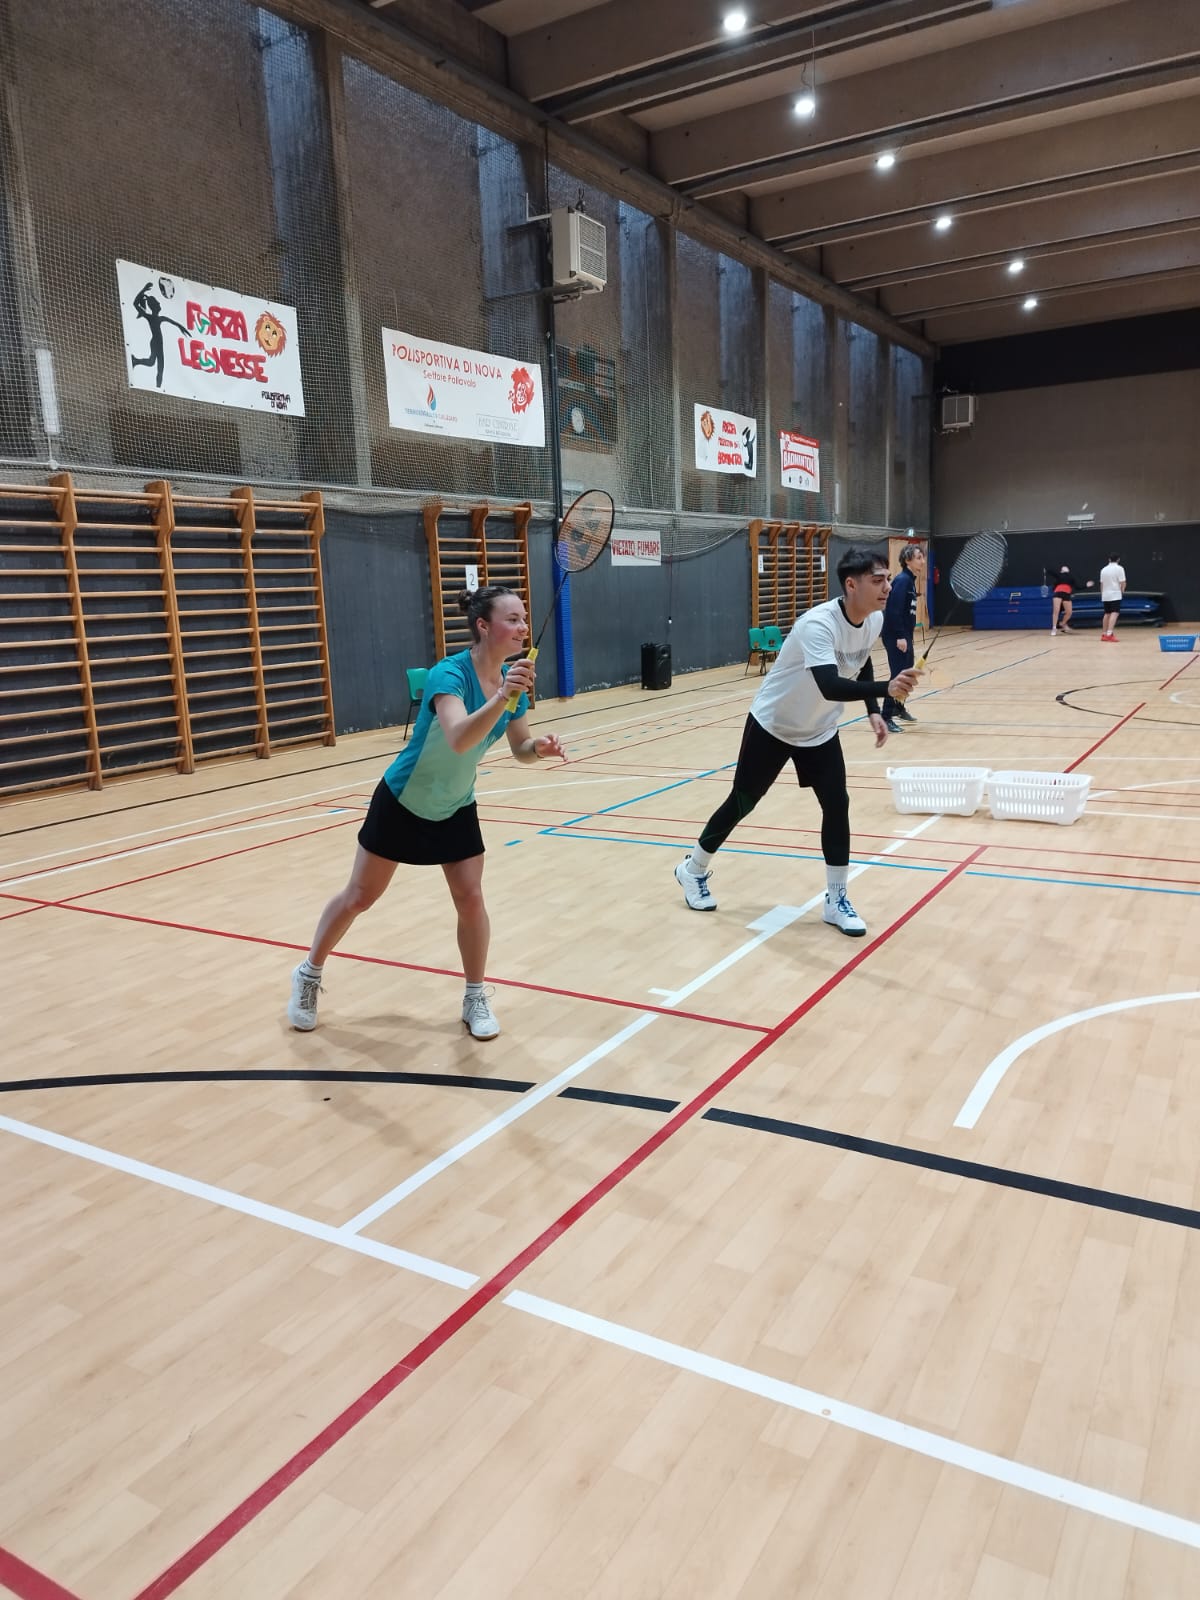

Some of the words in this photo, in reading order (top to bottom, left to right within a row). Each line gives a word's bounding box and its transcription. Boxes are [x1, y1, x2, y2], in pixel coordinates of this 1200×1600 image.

[178, 338, 268, 383] LEONESSE
[392, 344, 460, 371] POLISPORTIVA
[463, 360, 473, 374] DI
[475, 364, 502, 379] NOVA
[784, 451, 814, 474] BADMINTON
[612, 540, 634, 556] VIETATO
[637, 541, 660, 556] FUMARE
[469, 573, 475, 586] 2
